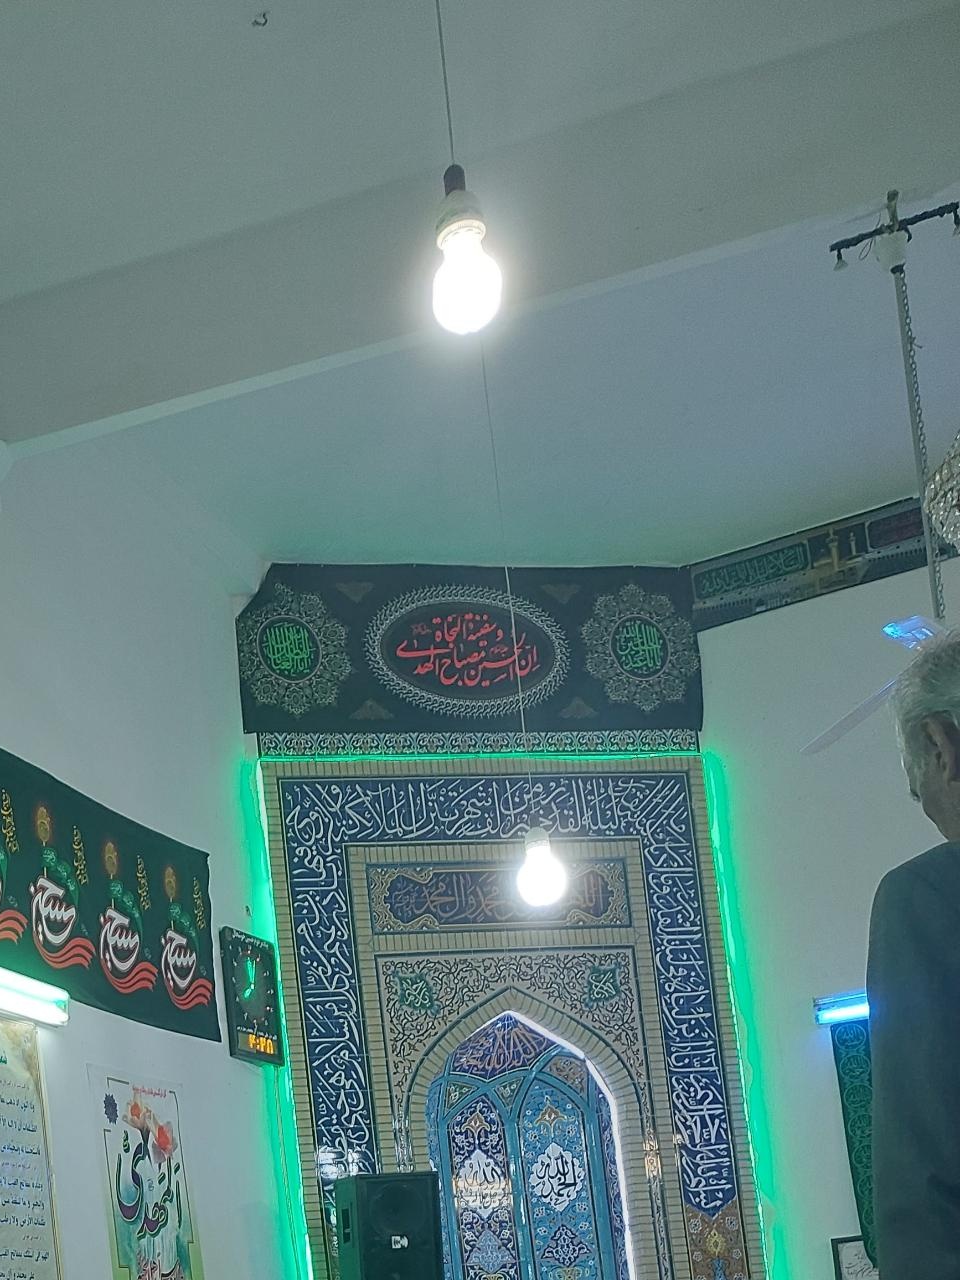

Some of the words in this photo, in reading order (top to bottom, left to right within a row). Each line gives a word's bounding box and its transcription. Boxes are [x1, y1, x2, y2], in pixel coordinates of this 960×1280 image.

[432, 614, 466, 647] النجاة
[466, 612, 496, 640] سفینة
[440, 640, 487, 685] مصباح
[445, 785, 492, 834] شهر
[501, 780, 543, 814] من
[290, 845, 327, 879] فیها
[31, 875, 76, 945] حسین
[100, 906, 140, 971] حسین
[162, 927, 196, 989] حسین
[308, 1018, 362, 1070] سلام
[116, 1130, 183, 1239] المهدی
